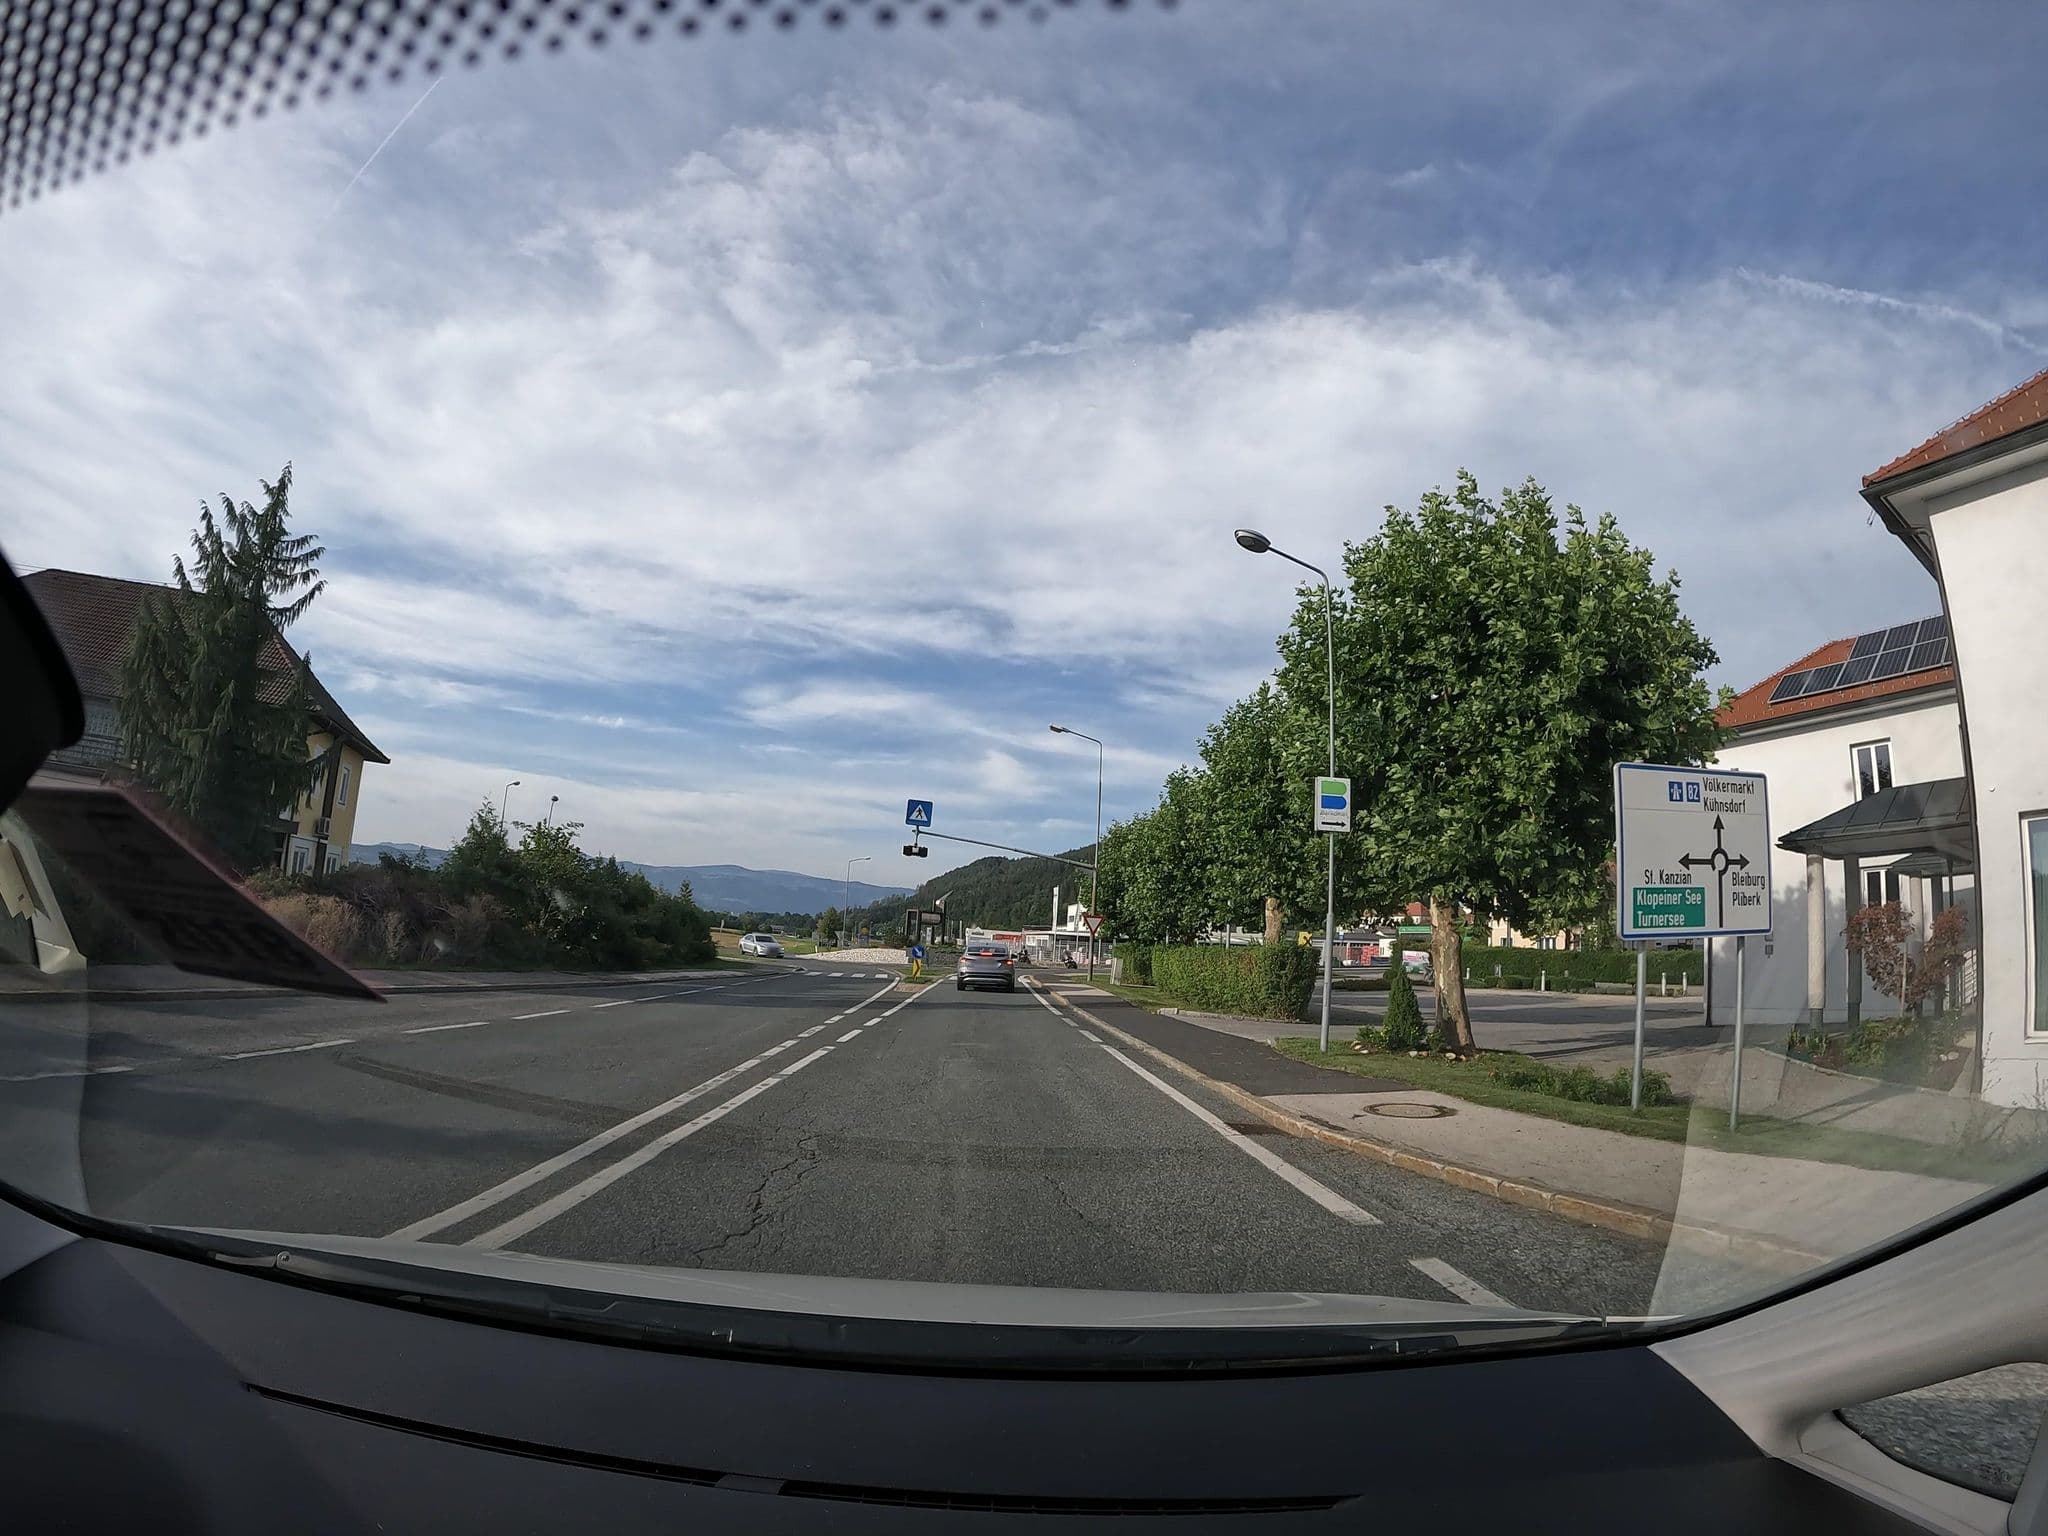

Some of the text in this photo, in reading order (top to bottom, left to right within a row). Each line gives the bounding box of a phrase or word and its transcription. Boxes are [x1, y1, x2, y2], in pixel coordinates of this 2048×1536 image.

[1687, 784, 1699, 800] 82
[1702, 777, 1755, 795] Völkermarkt
[1703, 797, 1746, 814] Kühnsdorf
[1644, 869, 1692, 885] St. Kanzian
[1732, 872, 1766, 890] Bleiburg
[1636, 889, 1702, 909] Klopeiner See
[1732, 892, 1761, 906] Pliberk
[1637, 911, 1685, 927] Turnersee
